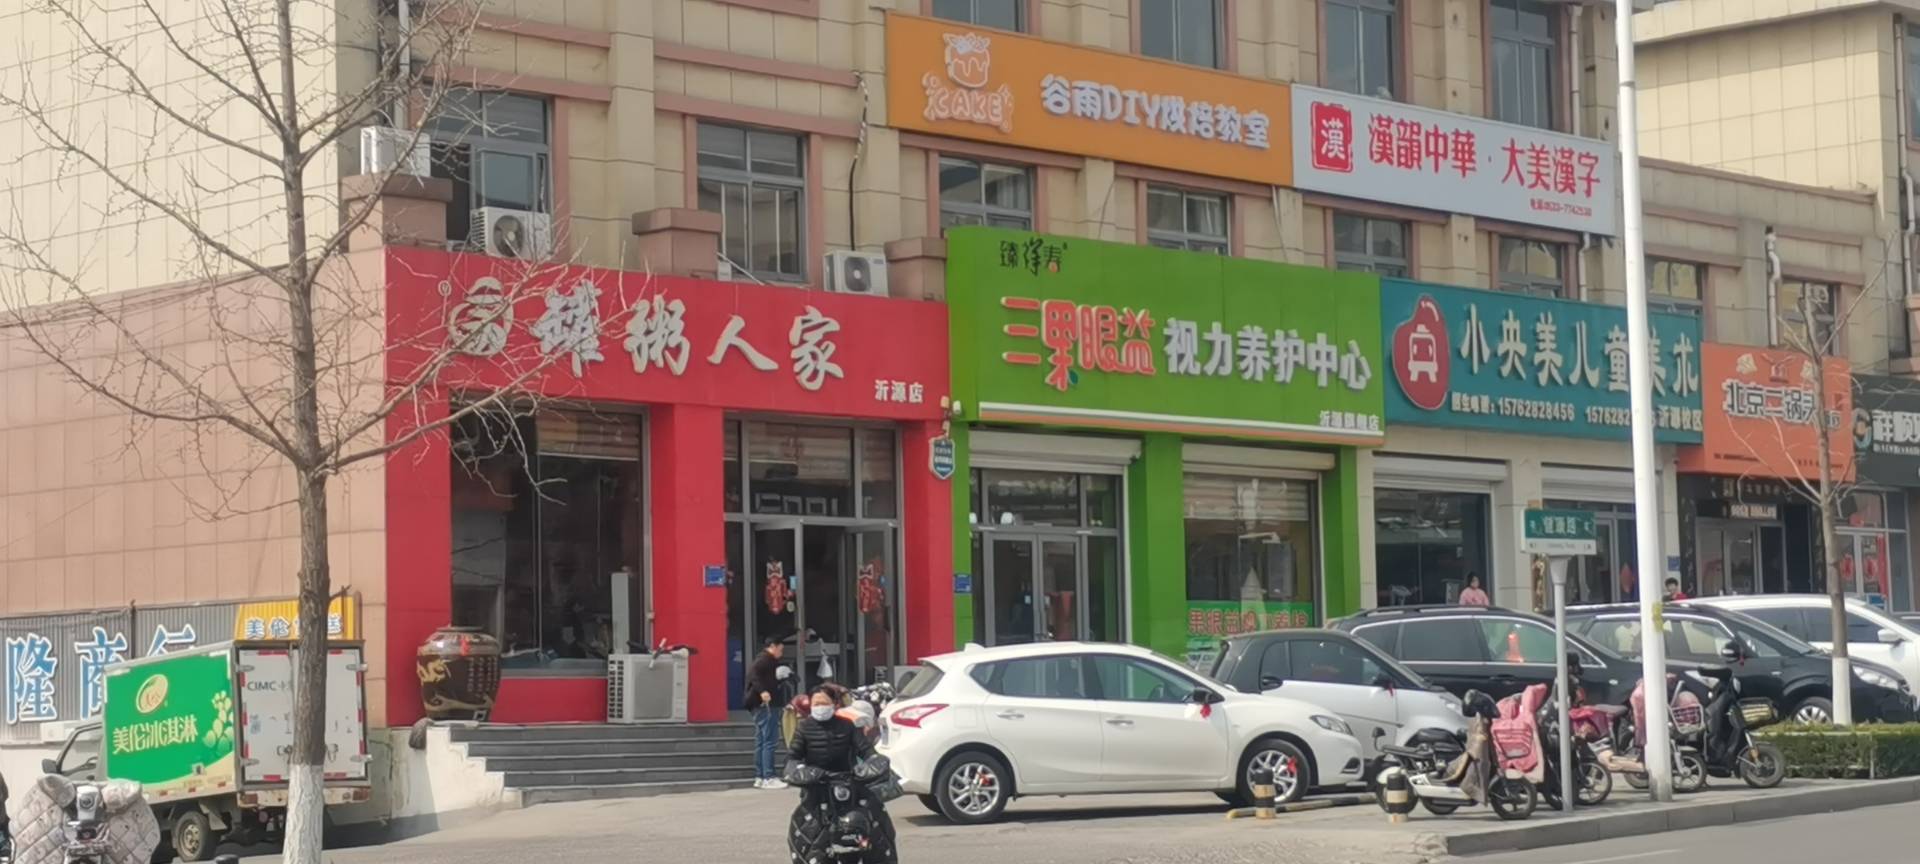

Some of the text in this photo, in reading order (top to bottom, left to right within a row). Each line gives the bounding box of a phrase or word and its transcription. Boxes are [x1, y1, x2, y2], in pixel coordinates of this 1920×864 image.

[934, 87, 1004, 122] CAKE
[1040, 73, 1271, 149] 谷雨DIY烘焙教室
[1320, 118, 1346, 161] 漢
[1001, 295, 1372, 392] 三果眼益 视力养护中心
[874, 379, 924, 405] 沂源店
[111, 713, 199, 755] 美伦冰淇淋
